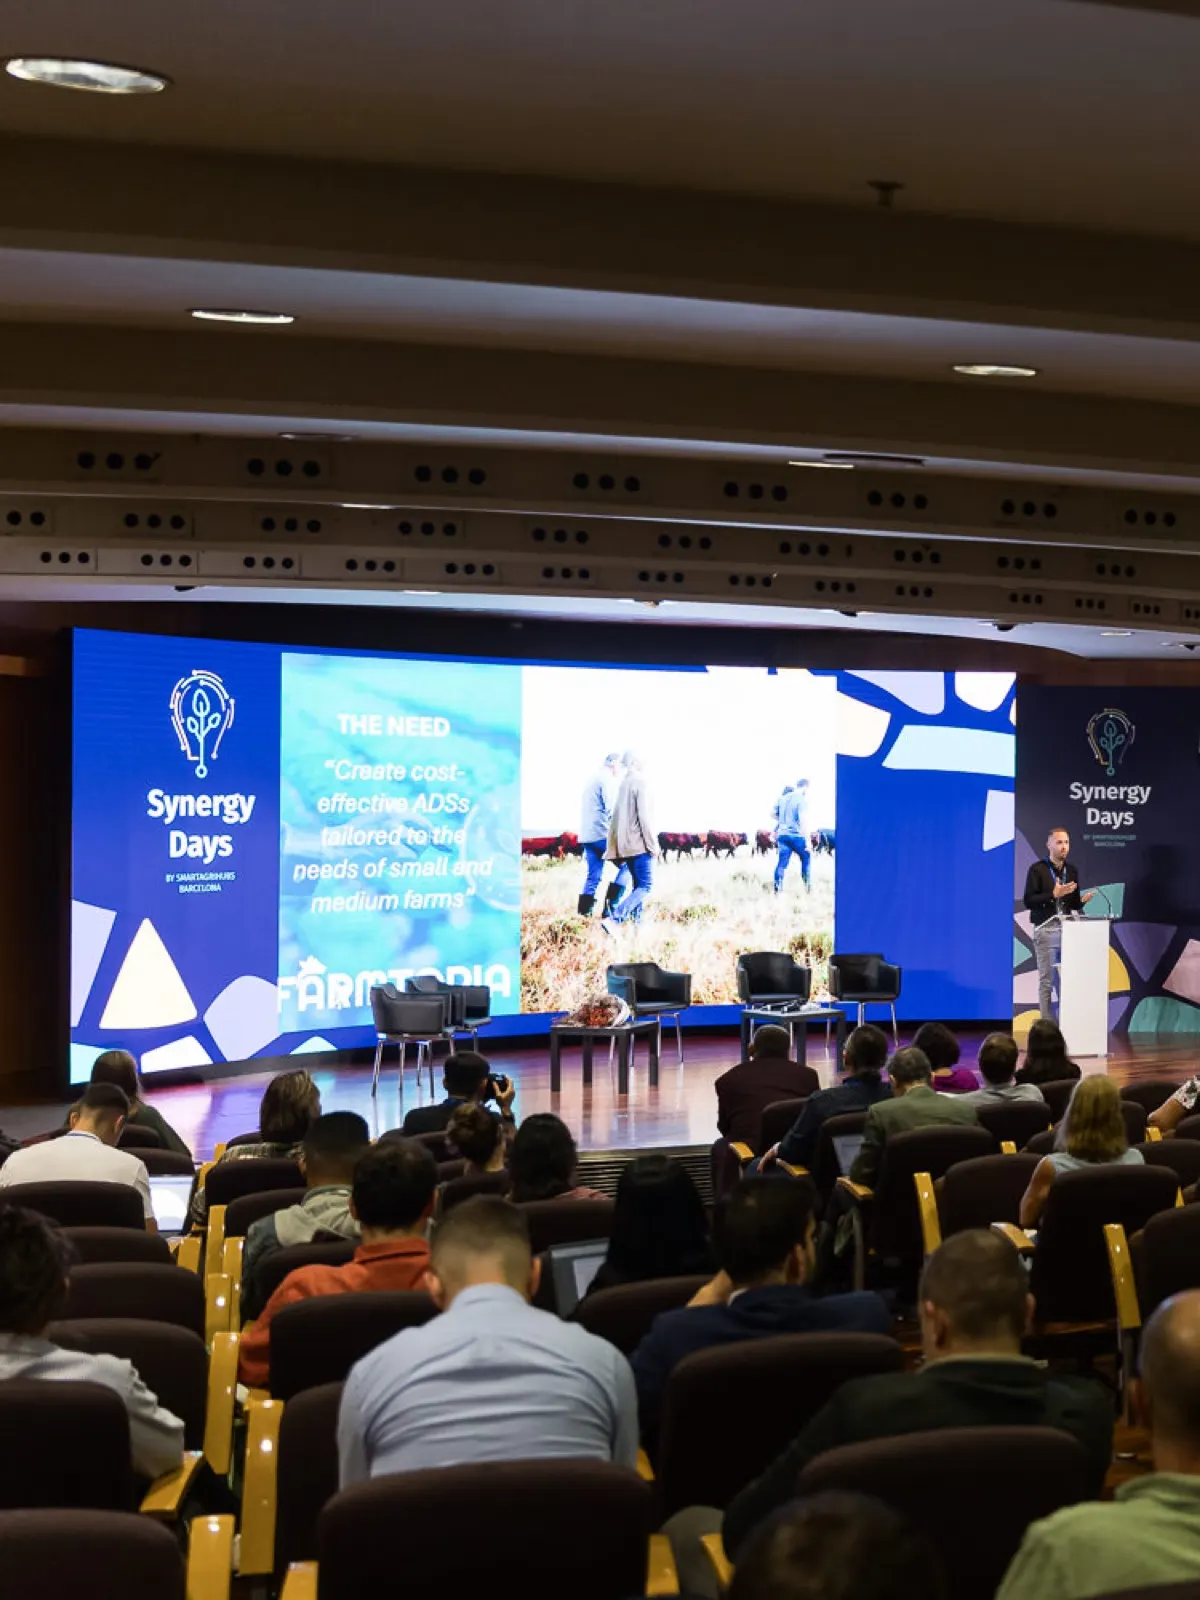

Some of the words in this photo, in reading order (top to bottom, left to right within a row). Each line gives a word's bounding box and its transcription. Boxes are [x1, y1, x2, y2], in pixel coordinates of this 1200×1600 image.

[337, 714, 383, 736] THE
[387, 715, 451, 738] NEED
[410, 764, 466, 782] cost-
[317, 792, 408, 813] effective
[412, 792, 470, 814] ADSs
[1069, 781, 1152, 805] Synergy
[147, 788, 256, 825] Synergy
[1086, 807, 1135, 830] Days
[169, 829, 233, 865] Days
[321, 825, 400, 847] tailored
[407, 826, 428, 845] to
[432, 825, 467, 845] the
[293, 858, 358, 882] needs
[363, 857, 388, 880] of
[388, 856, 448, 878] small
[452, 857, 494, 878] and
[311, 891, 399, 914] medium
[277, 963, 511, 1013] FARMTPIA
